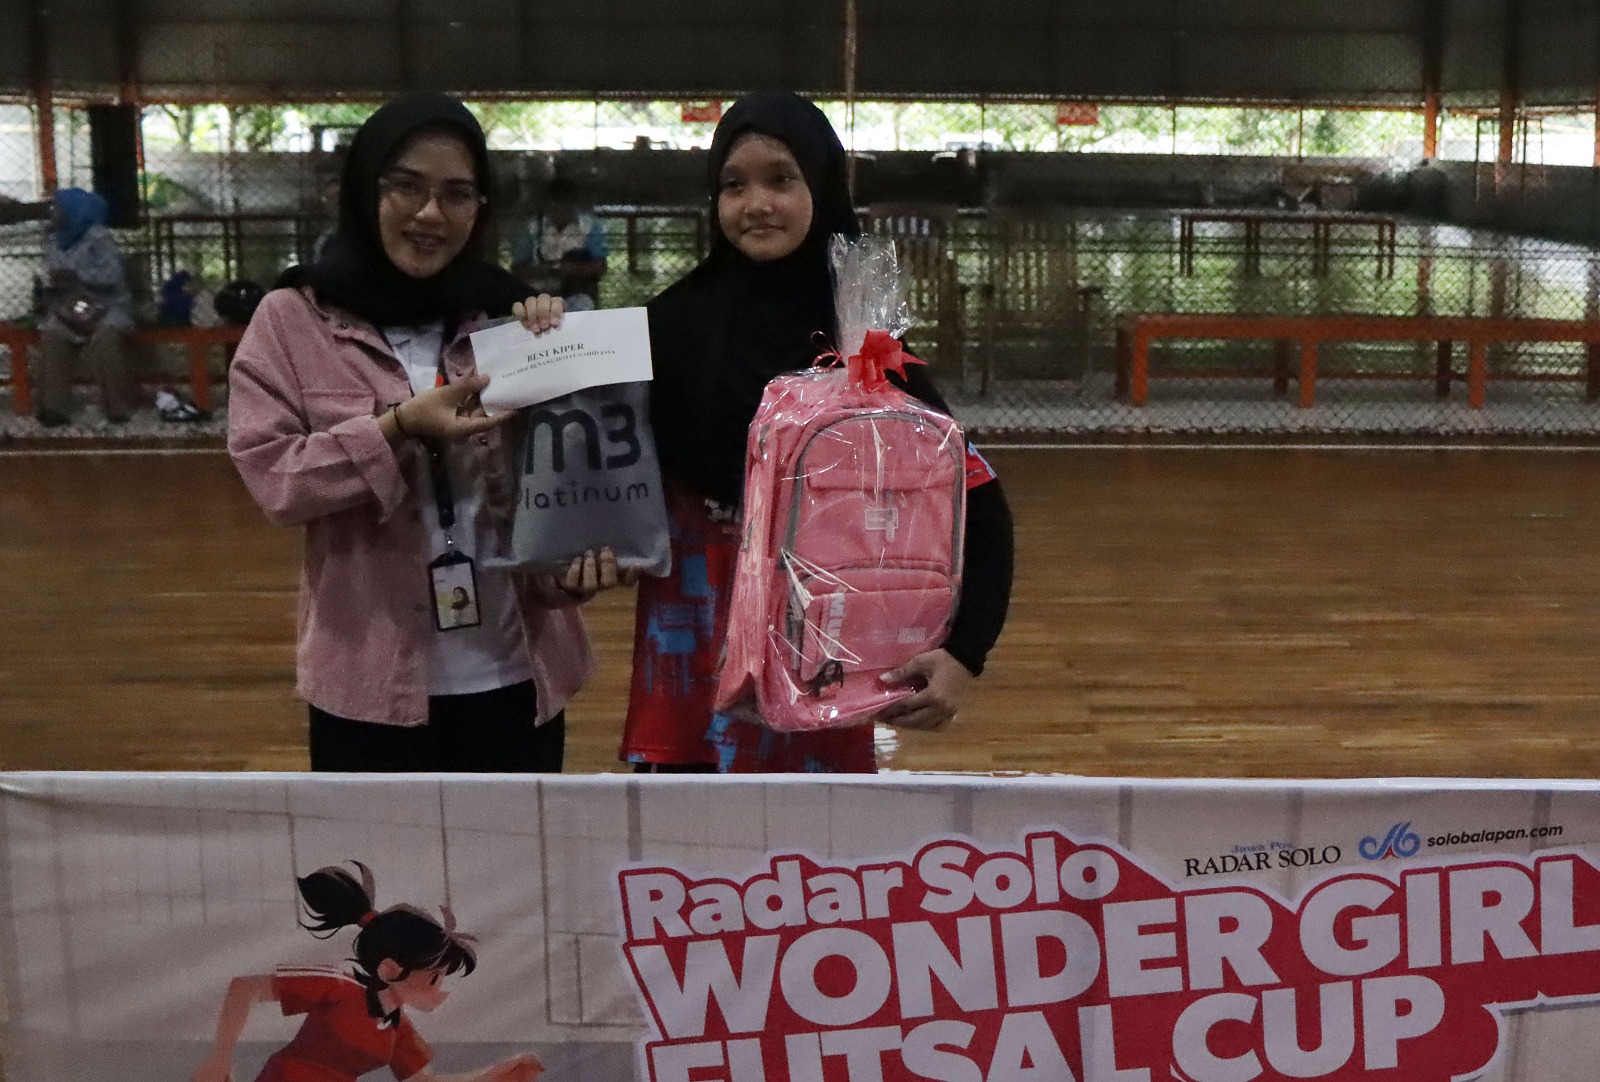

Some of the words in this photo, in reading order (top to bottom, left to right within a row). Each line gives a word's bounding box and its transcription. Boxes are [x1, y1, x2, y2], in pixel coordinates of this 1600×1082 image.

[527, 349, 550, 362] BEST
[552, 343, 584, 356] KIPER
[519, 482, 649, 509] latinum
[1427, 825, 1563, 847] solobalapan.com
[1184, 852, 1272, 877] RADAR
[1278, 845, 1341, 868] SOLO
[624, 860, 903, 940] Radar
[918, 837, 1120, 913] Solo
[630, 897, 1280, 1039] WONDER
[1300, 859, 1600, 976] GIRL
[1172, 974, 1445, 1082] CUP
